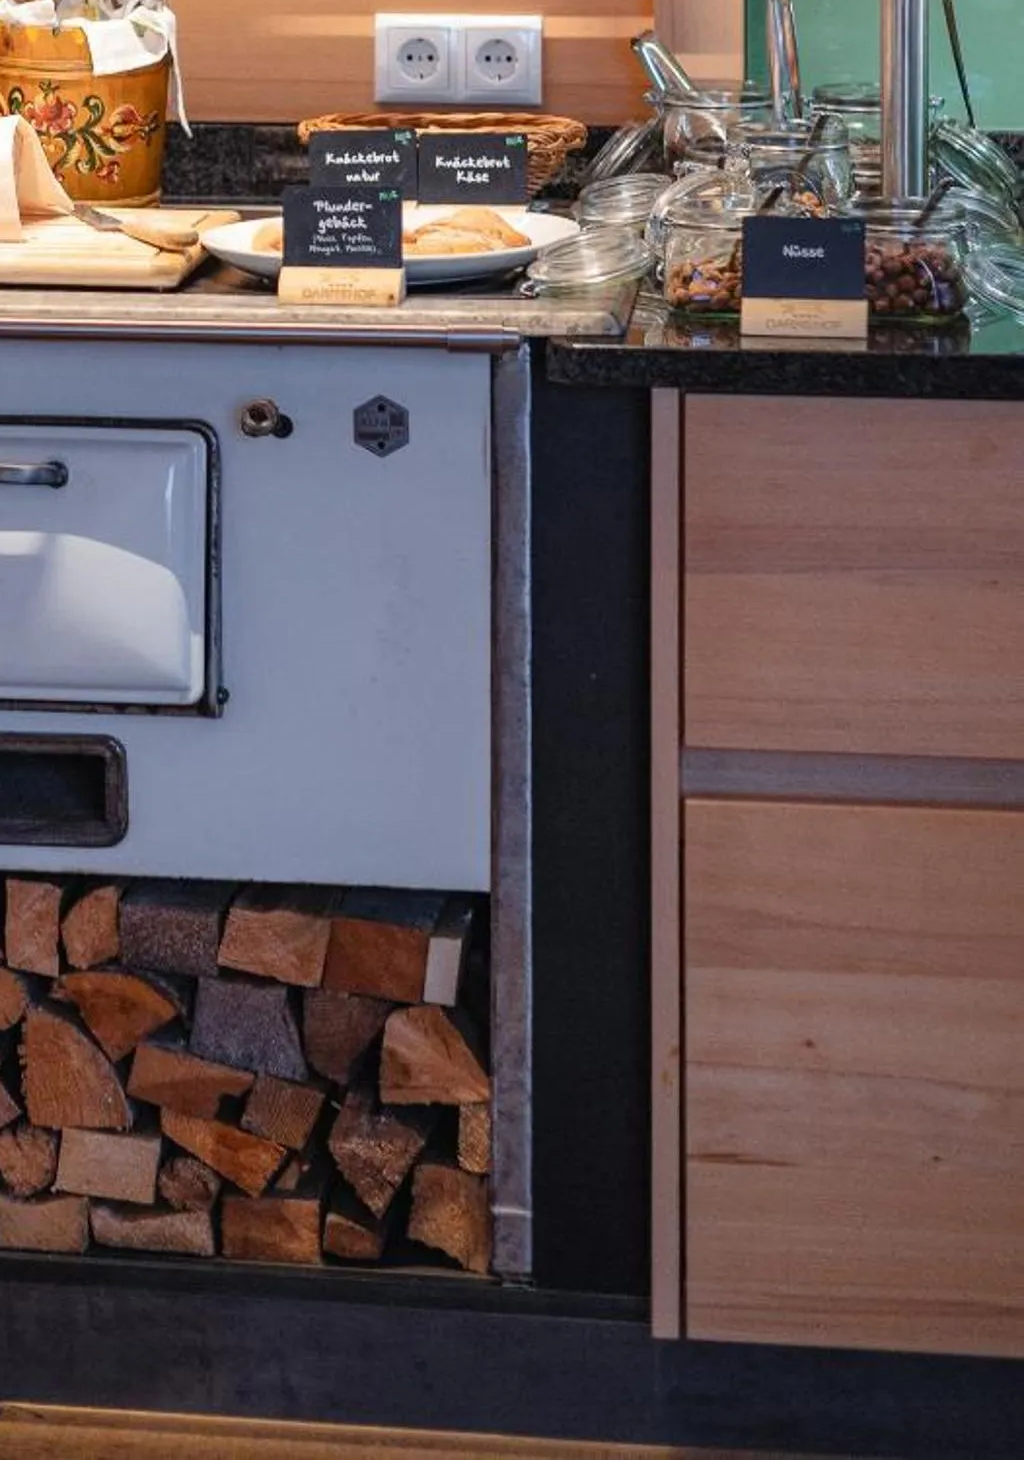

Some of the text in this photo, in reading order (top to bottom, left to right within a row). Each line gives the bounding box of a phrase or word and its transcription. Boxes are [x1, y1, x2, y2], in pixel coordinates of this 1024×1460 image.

[325, 149, 400, 166] Knäckebrot
[435, 154, 511, 169] Knäckebrot
[346, 168, 381, 182] natur
[456, 169, 490, 184] Käse
[782, 244, 825, 258] Nüsse
